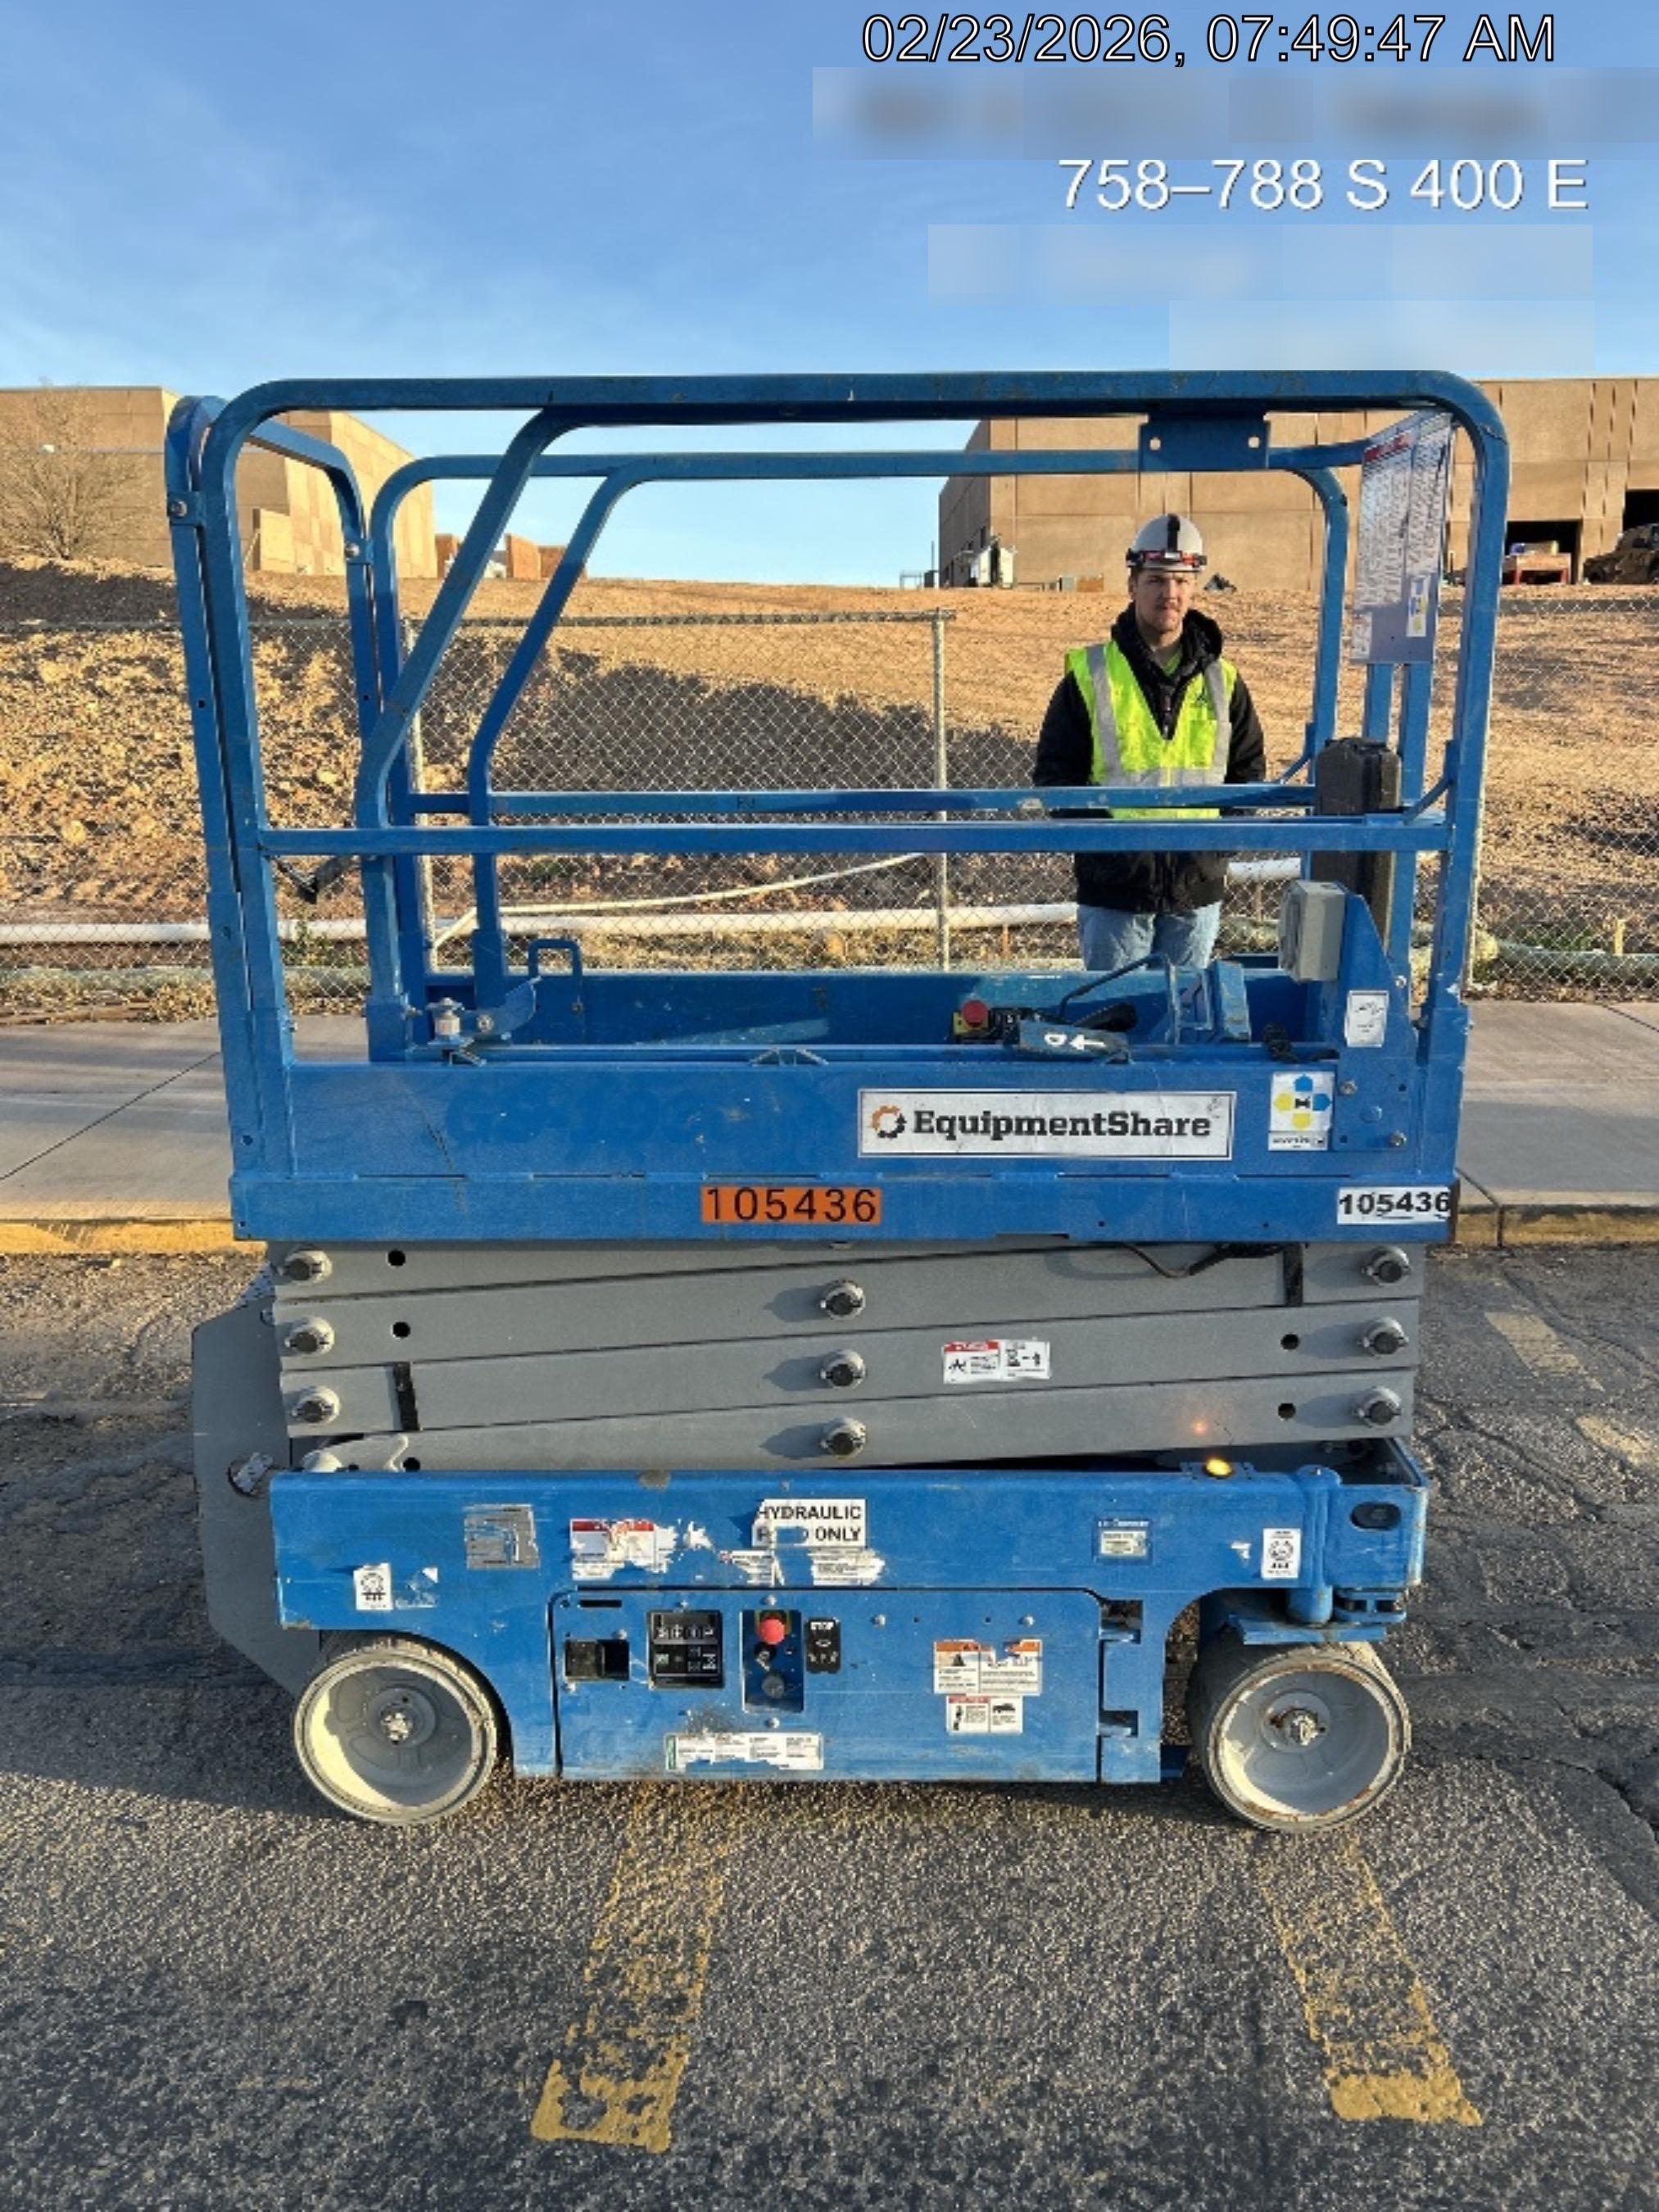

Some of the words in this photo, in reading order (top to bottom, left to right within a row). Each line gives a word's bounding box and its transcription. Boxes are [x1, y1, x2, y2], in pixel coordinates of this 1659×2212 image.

[913, 1109, 1212, 1140] EquipmentShare
[706, 1186, 877, 1222] 105436
[1339, 1191, 1451, 1215] 105436
[759, 1505, 862, 1521] HYDRAULIC
[814, 1525, 861, 1542] ONLY
